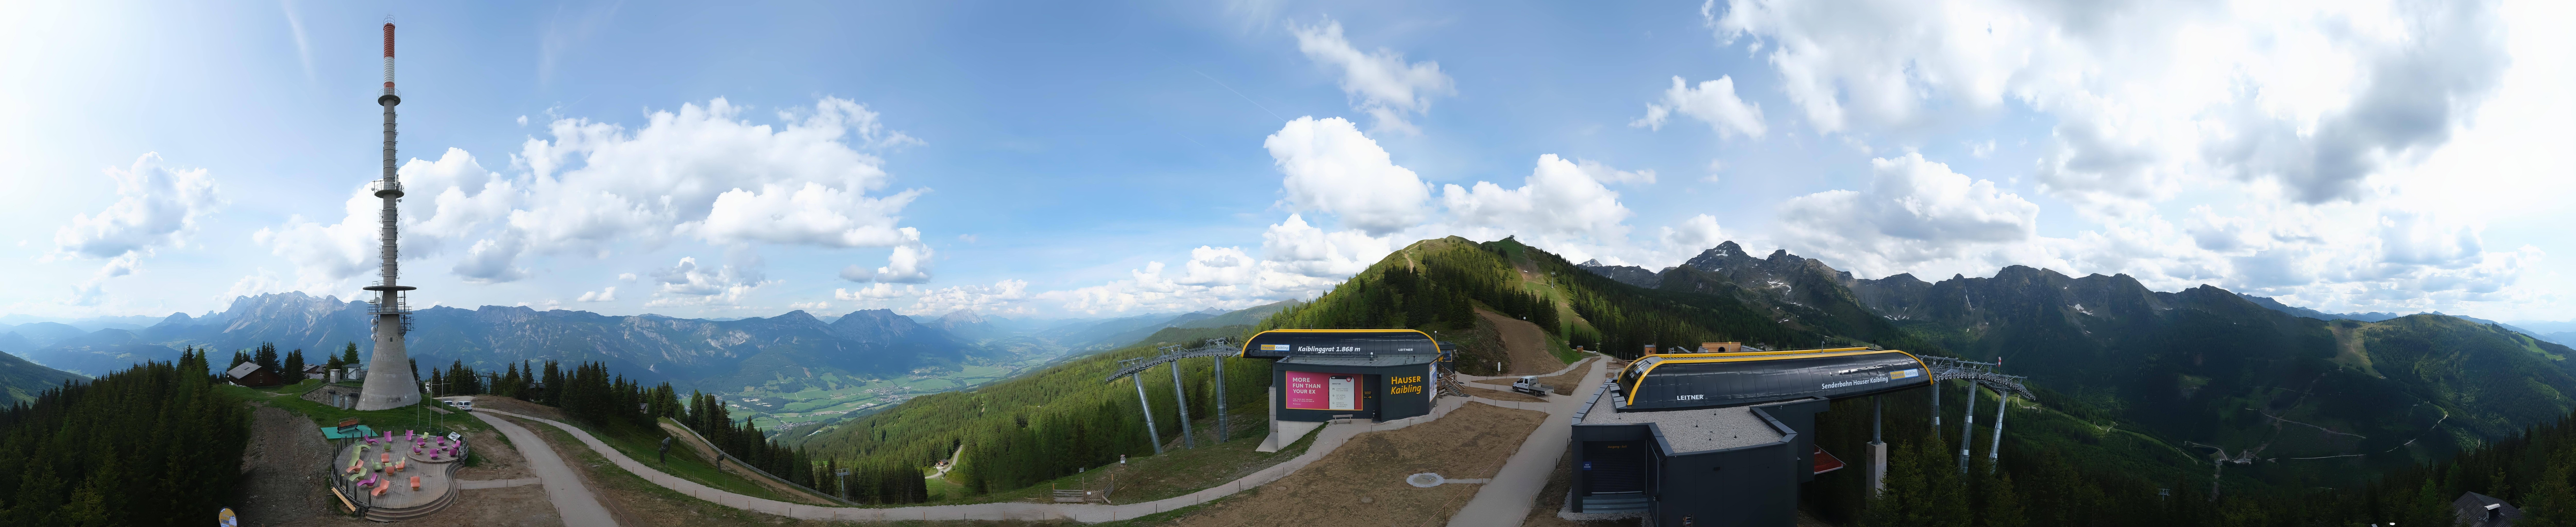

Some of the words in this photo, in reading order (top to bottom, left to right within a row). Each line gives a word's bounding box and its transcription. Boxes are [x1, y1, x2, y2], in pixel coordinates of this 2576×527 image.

[1392, 376, 1421, 385] HAUSER
[1822, 380, 1852, 389] Senderbahn
[1391, 385, 1421, 394] Kaibling
